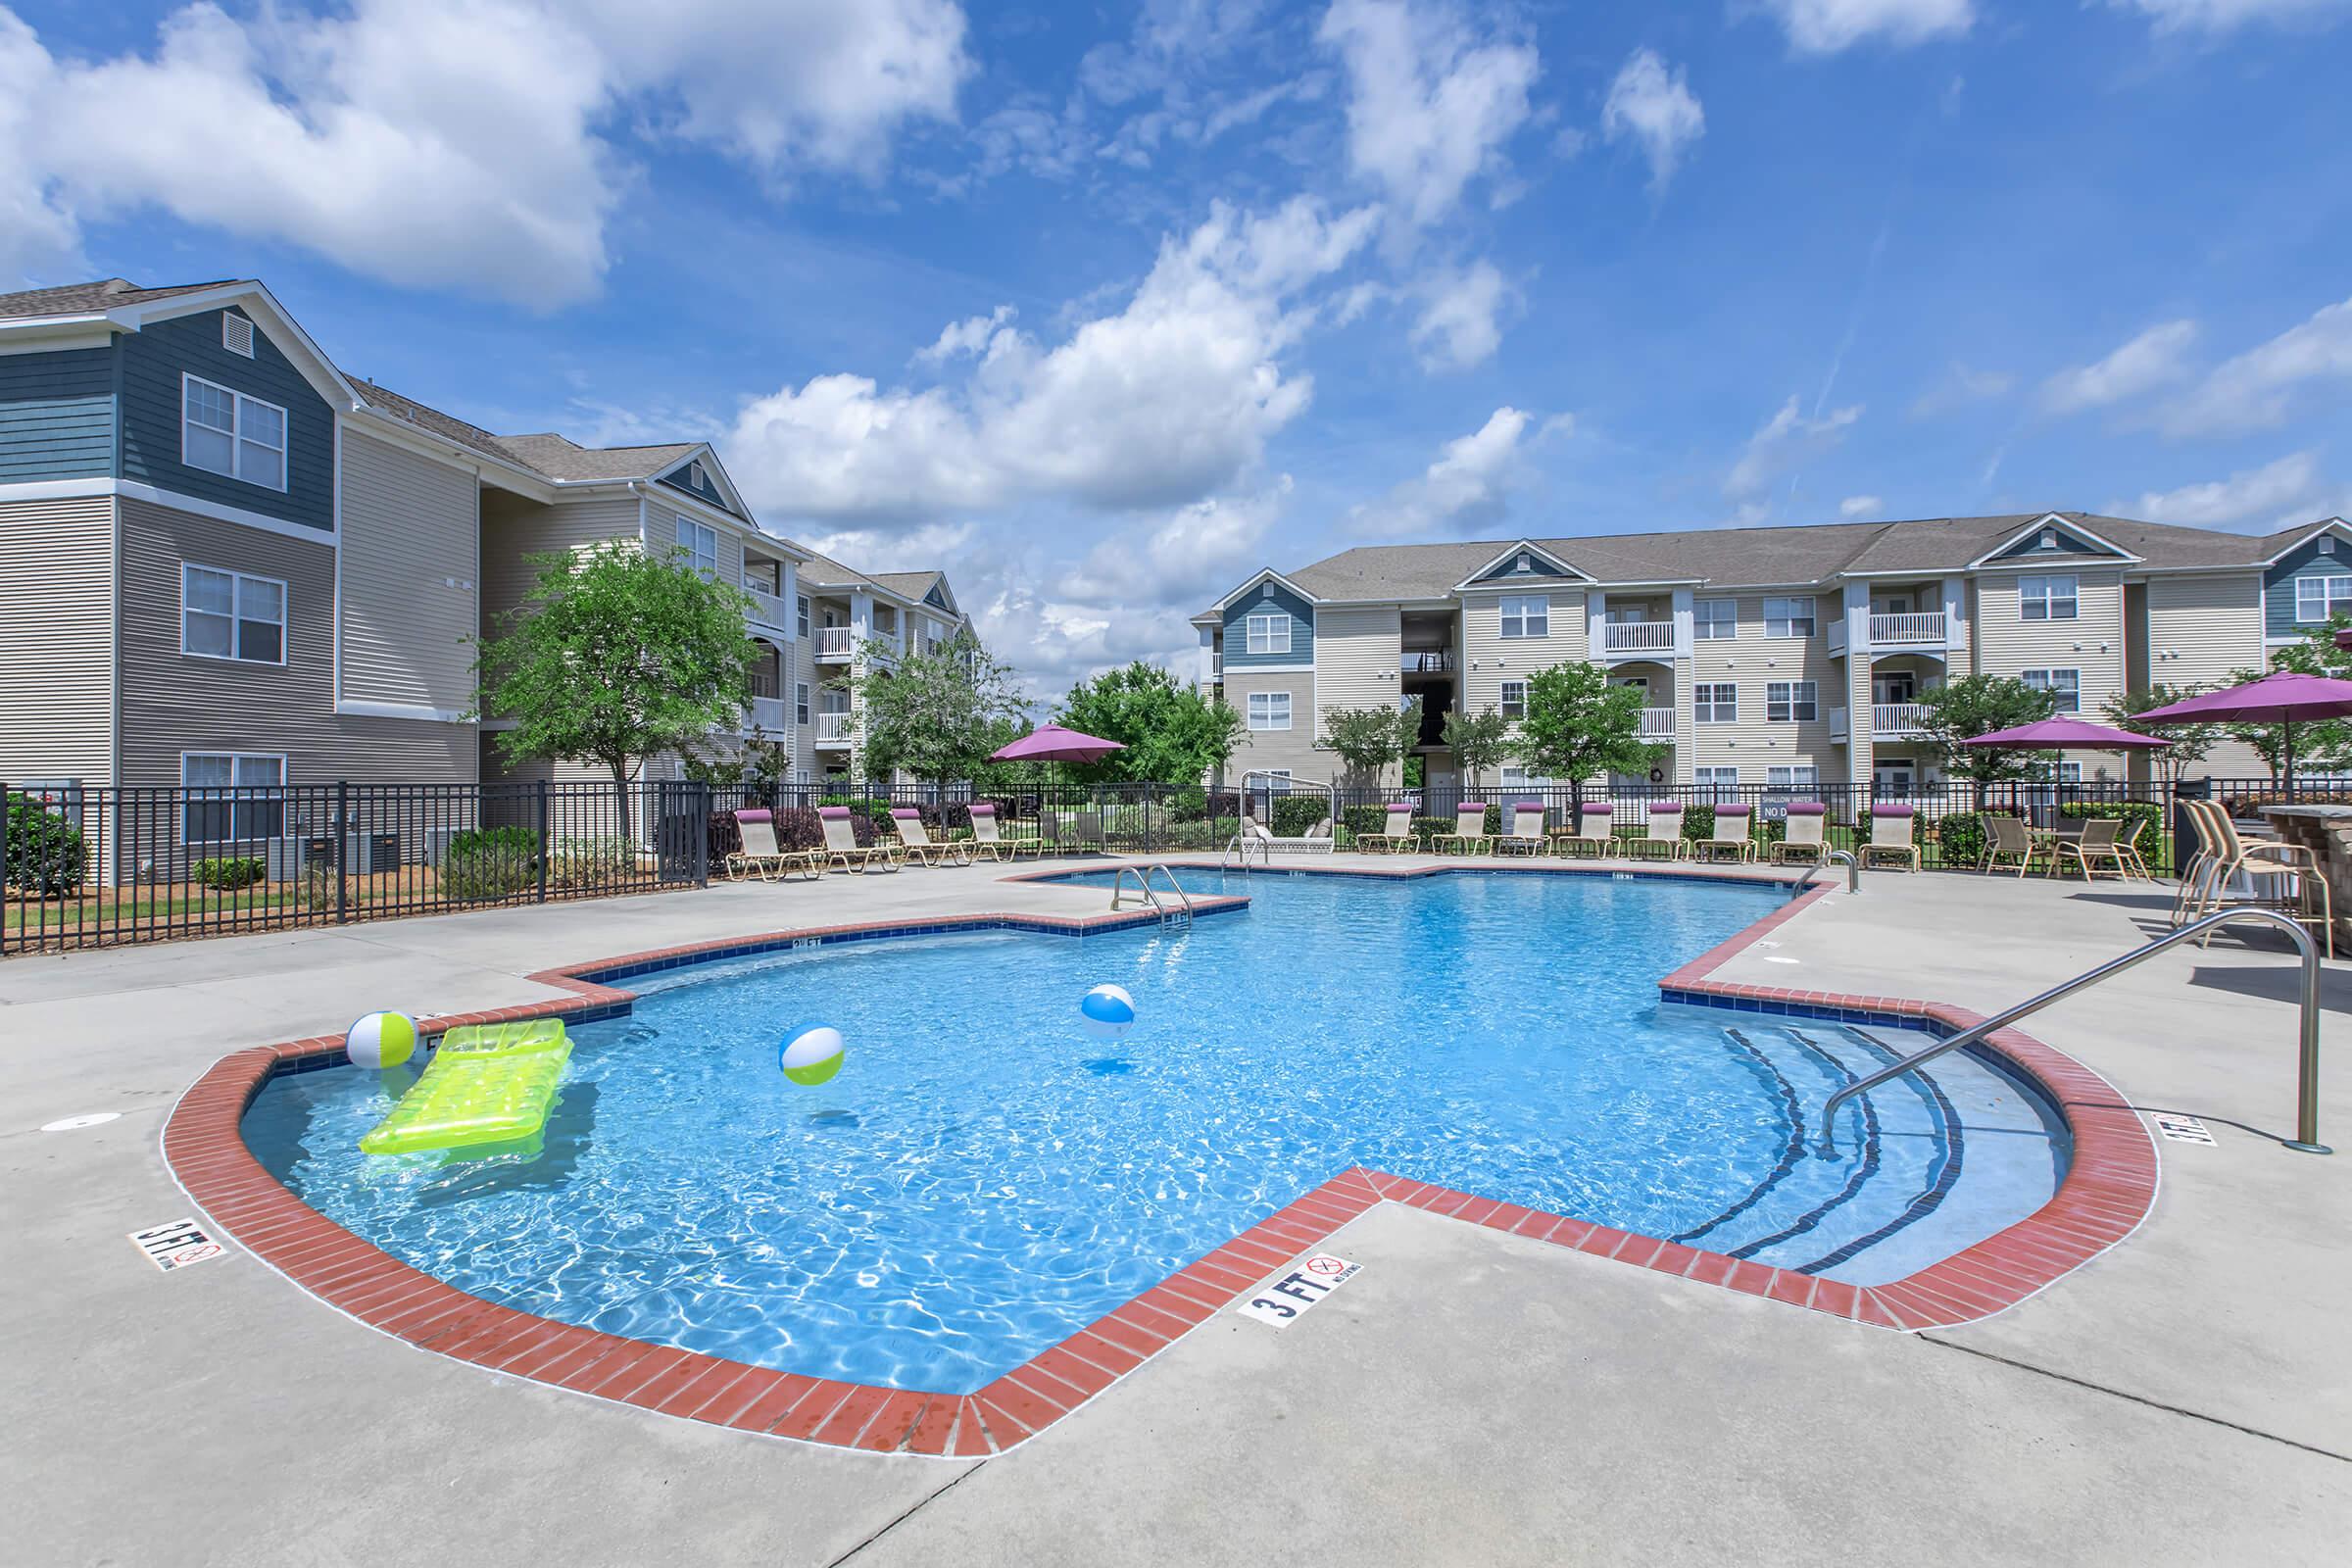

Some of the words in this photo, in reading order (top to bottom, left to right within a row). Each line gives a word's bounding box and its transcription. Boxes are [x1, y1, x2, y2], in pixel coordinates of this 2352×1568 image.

[1765, 807, 1779, 816] NO
[807, 936, 821, 947] FT
[2159, 1120, 2209, 1136] FT
[137, 1222, 194, 1240] 3
[144, 1230, 210, 1254] FT
[1272, 1272, 1331, 1303] FT
[1251, 1298, 1297, 1318] 3
